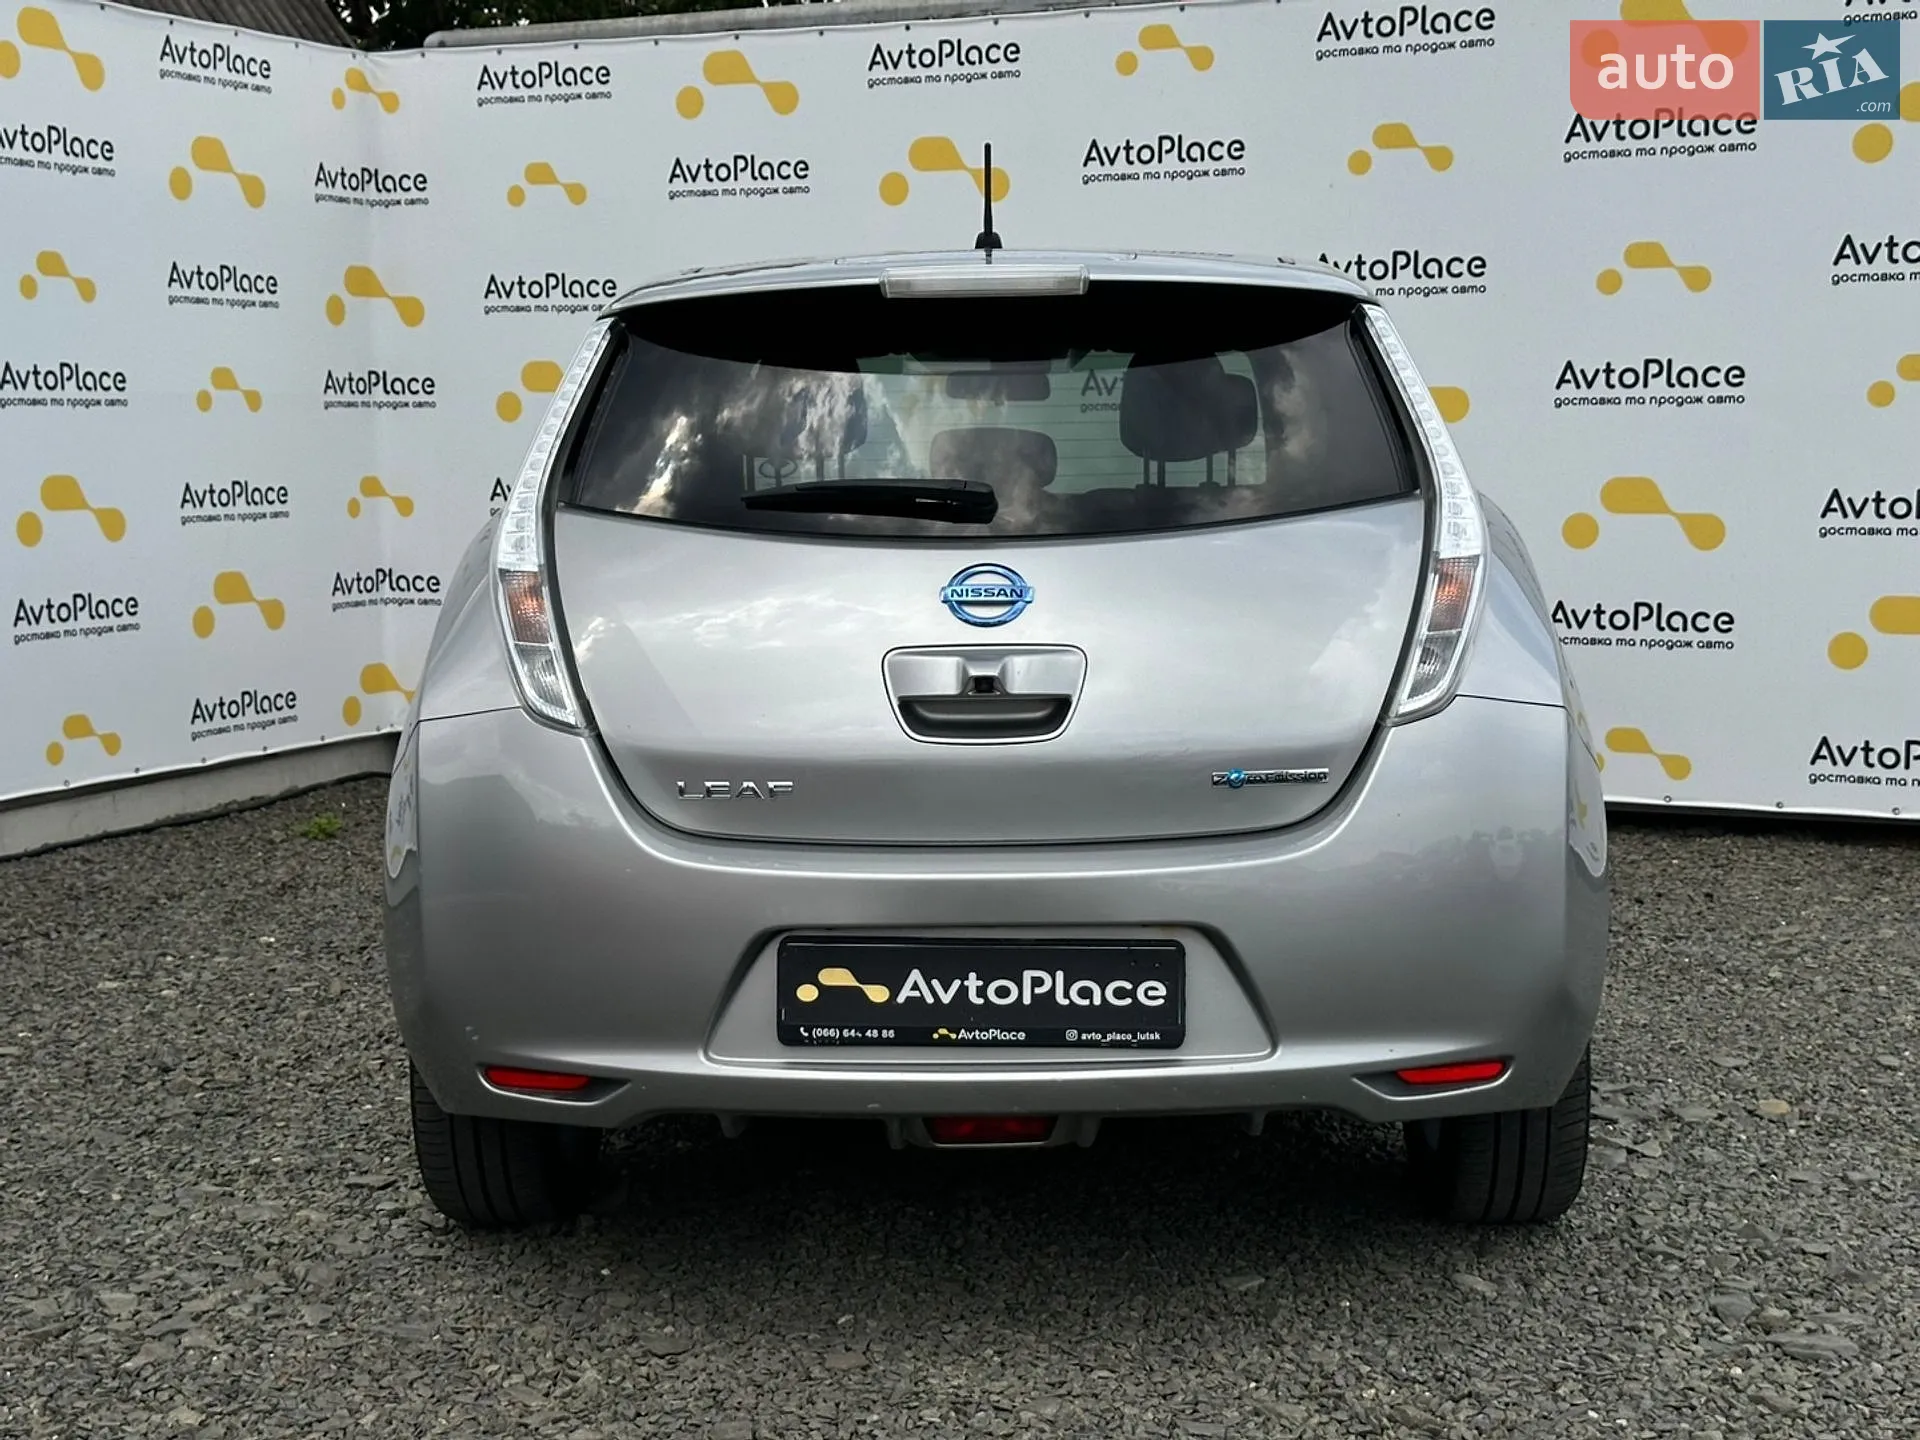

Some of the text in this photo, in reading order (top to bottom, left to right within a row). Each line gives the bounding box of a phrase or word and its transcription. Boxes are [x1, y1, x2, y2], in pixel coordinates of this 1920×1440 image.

[1317, 4, 1495, 42] AvtoPlace
[160, 34, 271, 79] AvtoPlace
[868, 38, 1021, 72] AvtoPlace
[1315, 37, 1495, 61] доставка та продаж авто
[477, 60, 611, 91] AvtoPlace
[867, 69, 1021, 89] доставка та продаж авто
[1564, 106, 1758, 144] AvtoPlace
[0, 123, 114, 161] vtoPlace
[1083, 134, 1246, 168] AvtoPlace
[1563, 141, 1758, 163] доставка та продаж авто
[0, 156, 35, 169] ставка
[315, 161, 428, 193] AvtoPlace
[668, 154, 810, 184] AvtoPlace
[1082, 167, 1246, 185] доставка та продаж авто
[168, 260, 278, 295] AvtoPlace
[484, 272, 617, 299] AvtoPlace
[1375, 285, 1487, 299] та продаж авто
[1831, 271, 1905, 286] доставка
[0, 361, 127, 392] AvtoPlace
[324, 369, 435, 395] AvtoPlace
[1555, 358, 1746, 391] AvtoPlace
[1554, 394, 1745, 409] доставка та продаж авто
[180, 479, 289, 509] AvtoPlace
[1818, 525, 1919, 539] доставка та
[331, 567, 441, 597] AvtoPlace
[950, 587, 1024, 599] NISSAN
[14, 592, 139, 628] AvtoPlace
[1551, 599, 1735, 634] AvtoPlace
[1558, 635, 1734, 651] ставка та продаж авто
[190, 689, 297, 725] AvtoPlace
[1809, 735, 1920, 771] AvtoP
[676, 781, 794, 800] LEAF
[1808, 773, 1881, 787] доставка
[1885, 775, 1907, 788] та
[896, 968, 1167, 1006] AvtoPlace
[812, 1028, 840, 1040] (066)
[864, 1030, 879, 1039] 48
[881, 1030, 895, 1039] 86
[957, 1028, 1027, 1041] AvtoPlace
